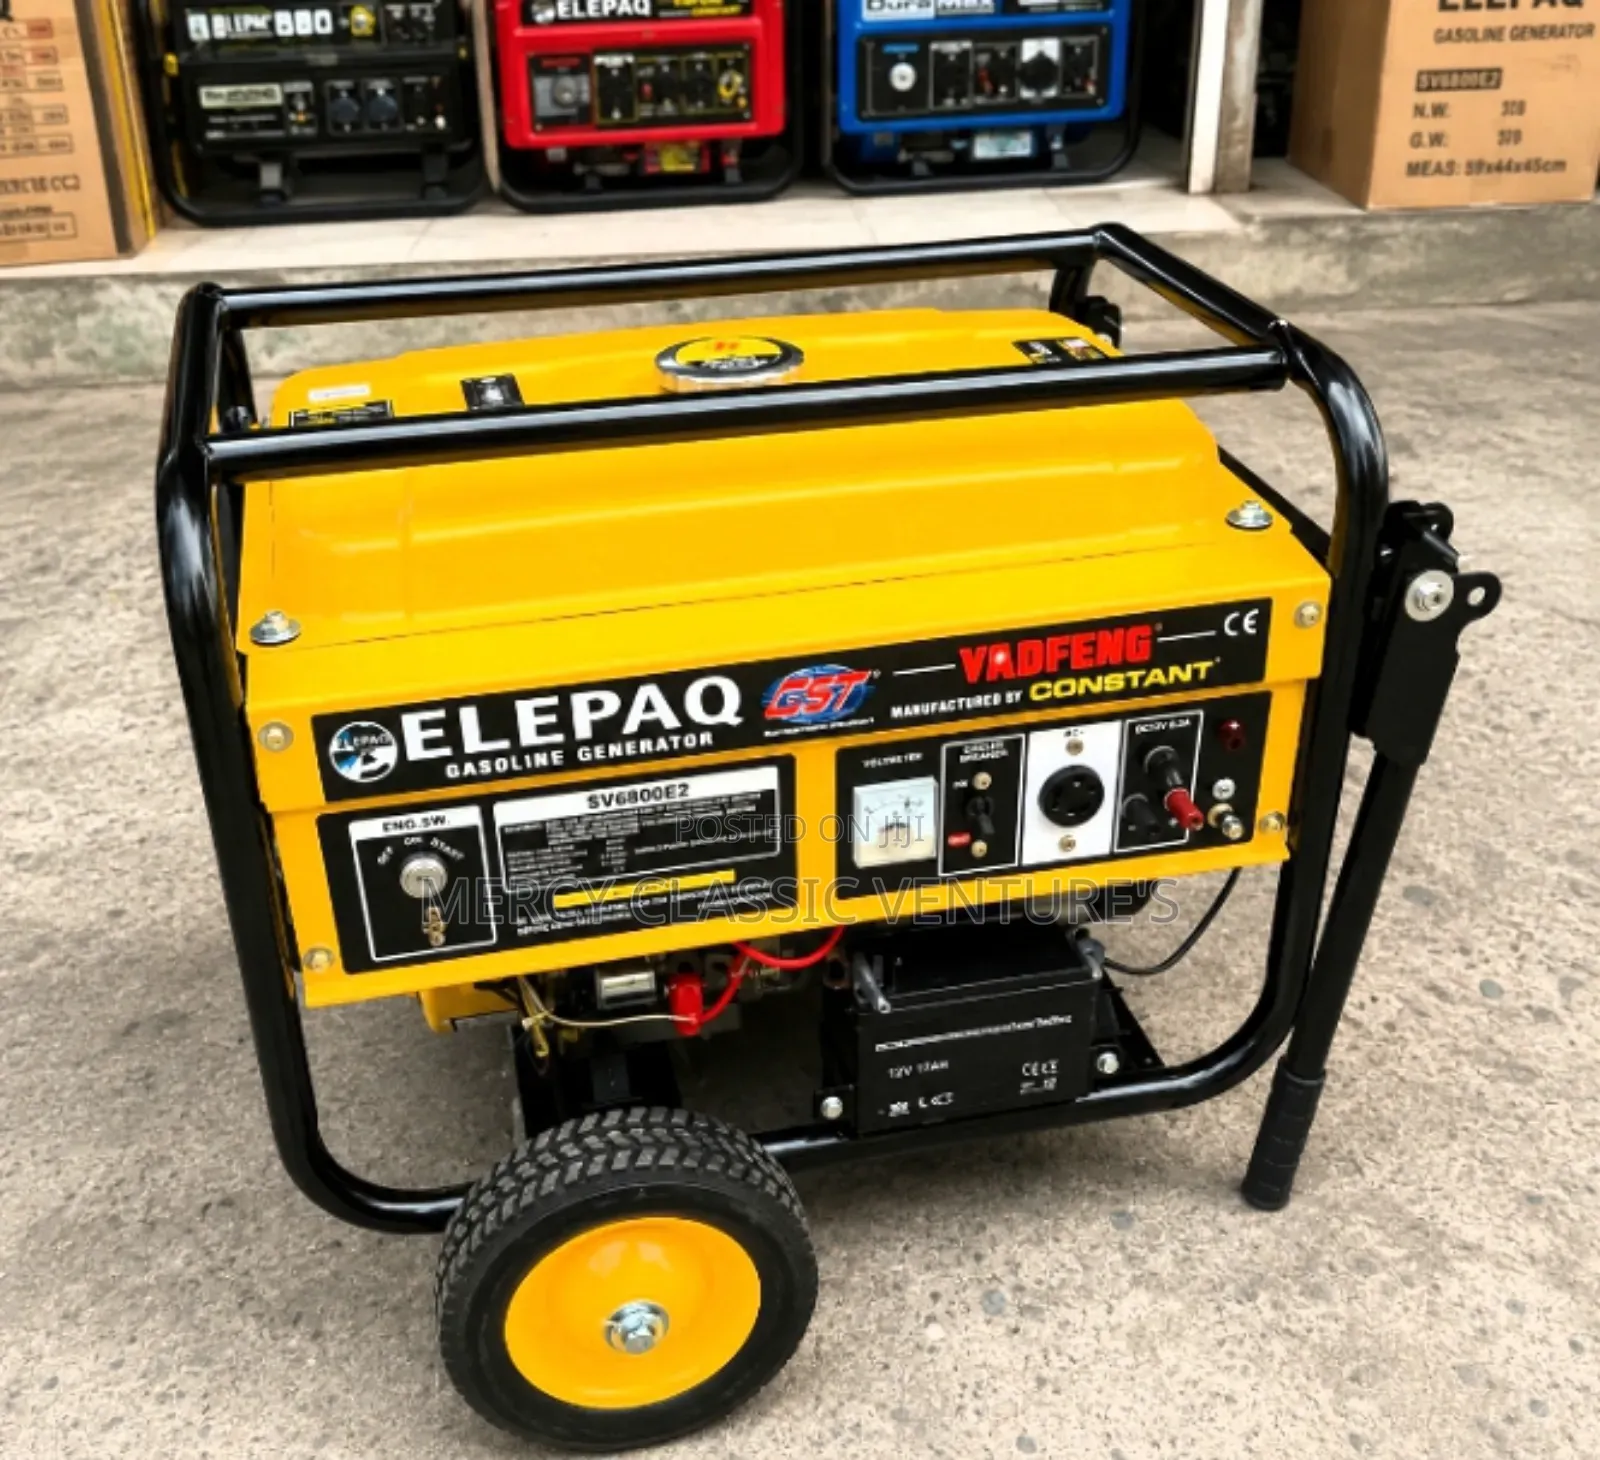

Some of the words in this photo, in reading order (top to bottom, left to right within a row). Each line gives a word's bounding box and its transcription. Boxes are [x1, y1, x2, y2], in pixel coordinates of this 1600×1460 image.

[1434, 27, 1505, 44] GASOLINE
[1510, 23, 1595, 41] GENERATOR
[890, 692, 1002, 719] MANUFACTURED
[1005, 690, 1023, 704] BY
[1029, 661, 1214, 701] CONSTANT
[401, 675, 743, 761] ELEPAQ
[446, 750, 564, 779] GASOLINE
[577, 731, 713, 763] GENERATOR
[587, 784, 689, 809] SV6800E2
